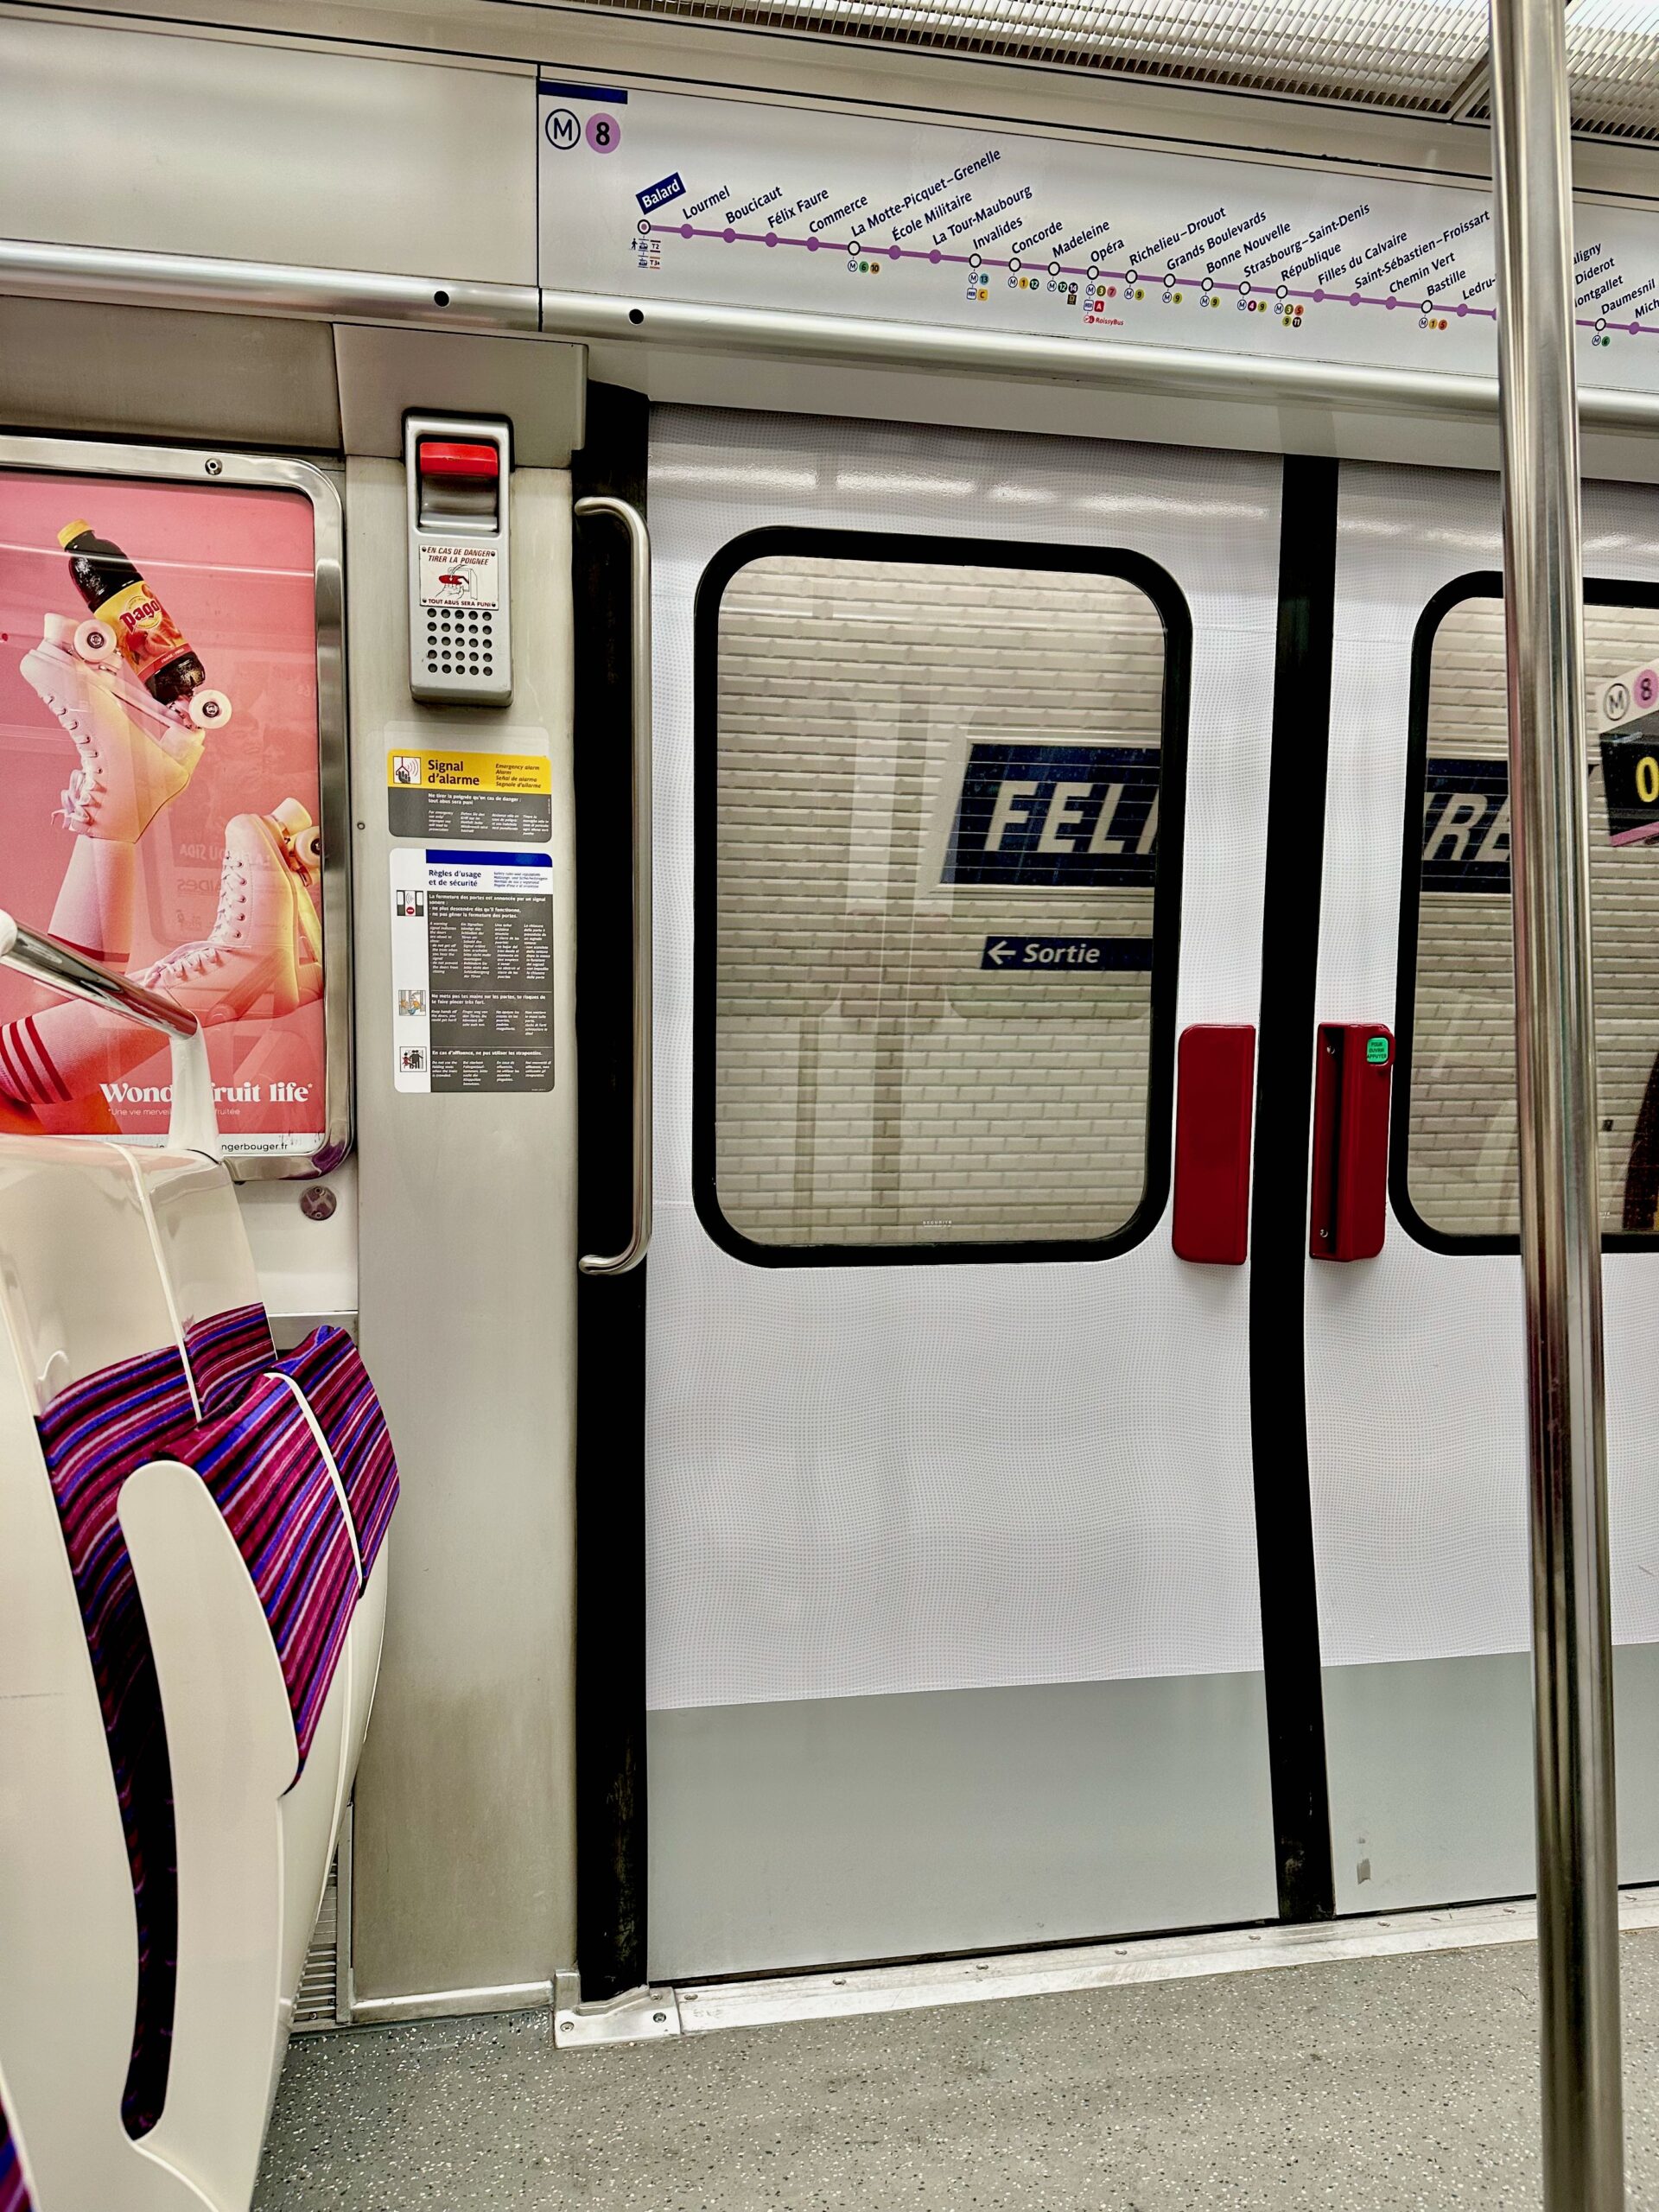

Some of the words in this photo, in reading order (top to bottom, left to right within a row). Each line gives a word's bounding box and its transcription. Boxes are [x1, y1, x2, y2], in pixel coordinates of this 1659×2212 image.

[595, 121, 610, 146] 8
[641, 179, 680, 209] Balard
[683, 186, 731, 220] Lourmel
[725, 186, 783, 225] Boucicaut
[767, 205, 795, 228] Félix
[797, 189, 830, 213] Faure
[809, 194, 868, 233] Commerce
[850, 223, 866, 237] La
[892, 219, 923, 242] École
[924, 191, 973, 223] Militaire
[932, 232, 947, 245] La
[947, 185, 1033, 238] Tour-Maubourg
[972, 215, 1023, 250] Invalides
[1011, 220, 1064, 255] Concorde
[1052, 220, 1110, 258] Madeleine
[1166, 244, 1205, 270] Grands
[1207, 211, 1267, 250] Boulevards
[1206, 250, 1242, 274] Bonne
[1243, 222, 1292, 254] Nouvelle
[1090, 238, 1125, 263] Opéra
[1281, 243, 1342, 282] République
[1318, 264, 1347, 285] Filles
[1349, 255, 1363, 269] du
[1364, 232, 1408, 259] Calvaire
[1389, 266, 1430, 293] Chemin
[1431, 251, 1456, 270] Vert
[1427, 270, 1466, 296] Bastille
[1574, 257, 1615, 285] Diderot
[1574, 275, 1624, 308] ontgallet
[1601, 278, 1656, 315] Daumesnil
[1096, 317, 1123, 326] RoissyBus
[463, 549, 491, 557] DANGER
[1642, 678, 1652, 701] 8
[428, 760, 464, 773] Signal
[428, 773, 480, 785] d'alarme
[1636, 757, 1659, 803] 0
[1422, 792, 1510, 861] RE
[429, 869, 452, 878] Règles
[454, 870, 481, 879] d'usage
[1022, 944, 1101, 963] Sortie
[221, 1141, 289, 1152] ngerbouger.fr
